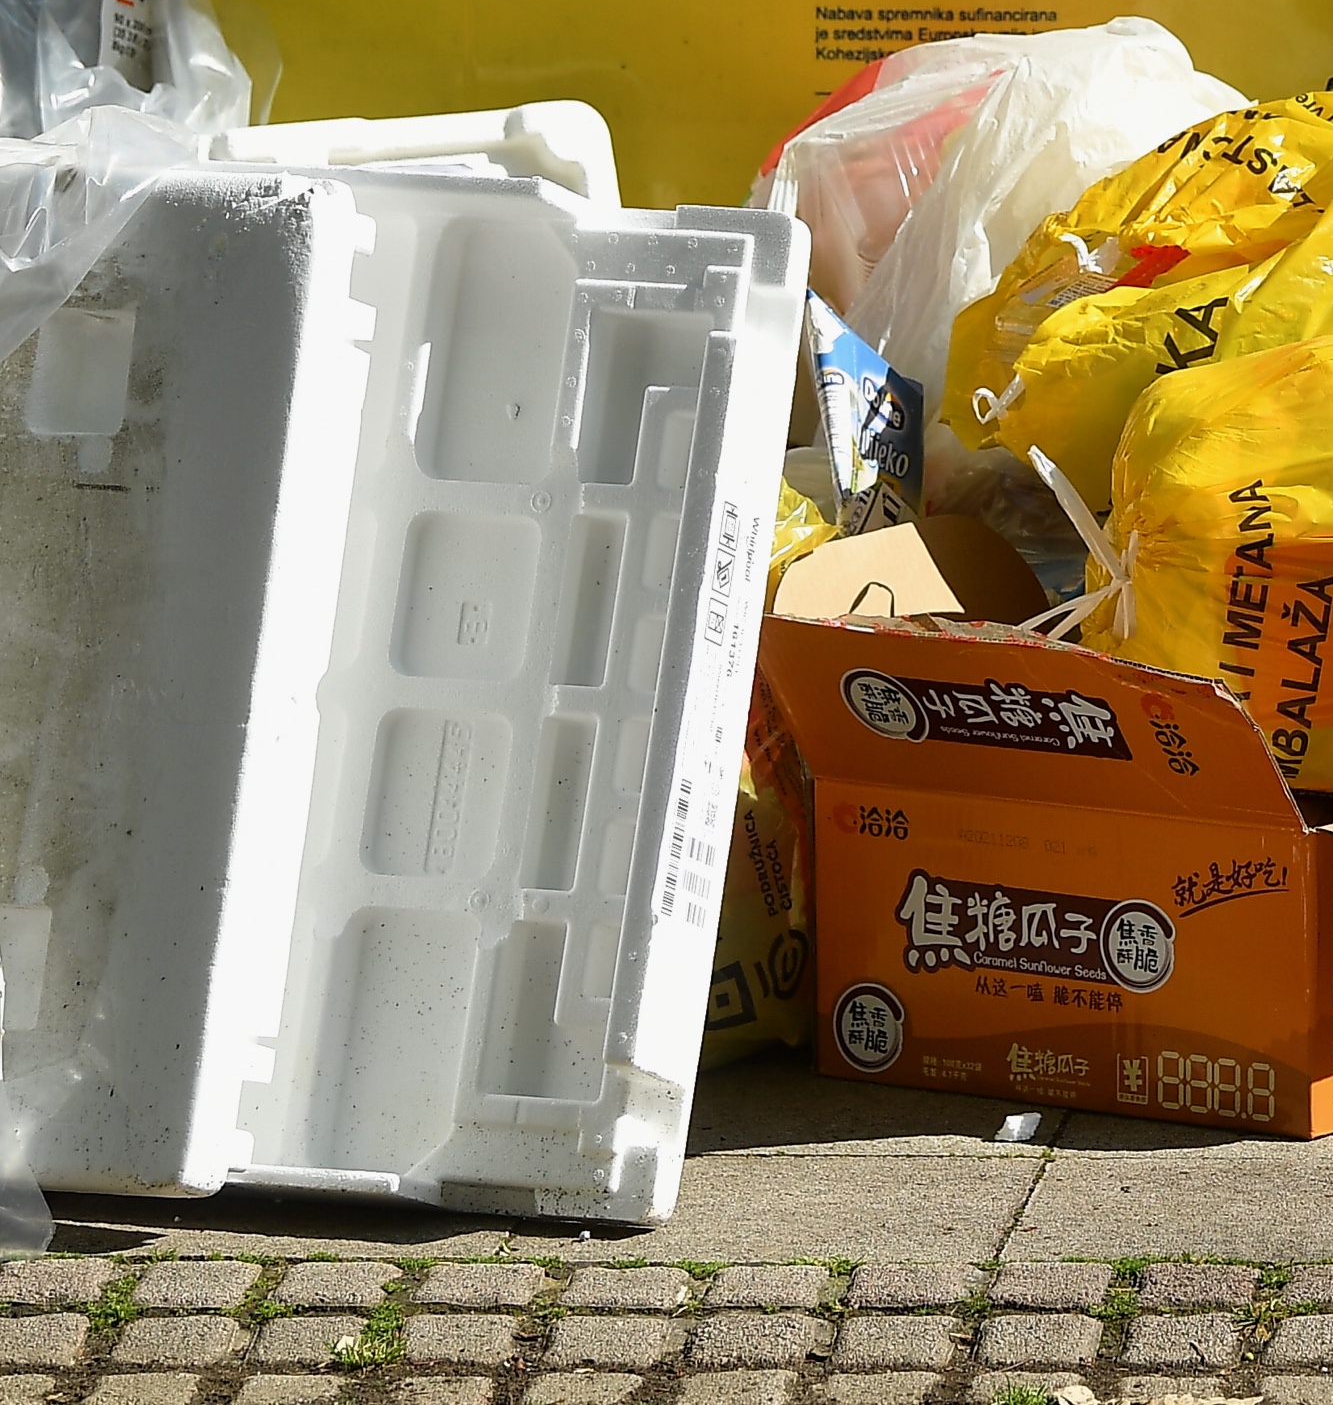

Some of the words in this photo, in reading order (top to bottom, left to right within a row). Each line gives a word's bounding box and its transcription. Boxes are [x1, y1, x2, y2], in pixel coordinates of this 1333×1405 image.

[814, 7, 873, 20] Nabava
[879, 7, 955, 23] spremnika
[959, 7, 1057, 22] sufinancirana
[814, 27, 828, 43] je
[833, 26, 914, 41] sredstvima
[922, 683, 1116, 751] 焦糖瓜子
[1020, 733, 1060, 747] Caramel
[857, 805, 910, 841] 洽洽
[744, 808, 779, 917] PODRUŽNICA
[899, 875, 1098, 969] 焦糖瓜子
[973, 951, 1018, 970] Caramel
[1019, 957, 1073, 977] Sunflower
[1074, 962, 1108, 982] Seeds
[1006, 1041, 1091, 1082] 焦糖瓜子
